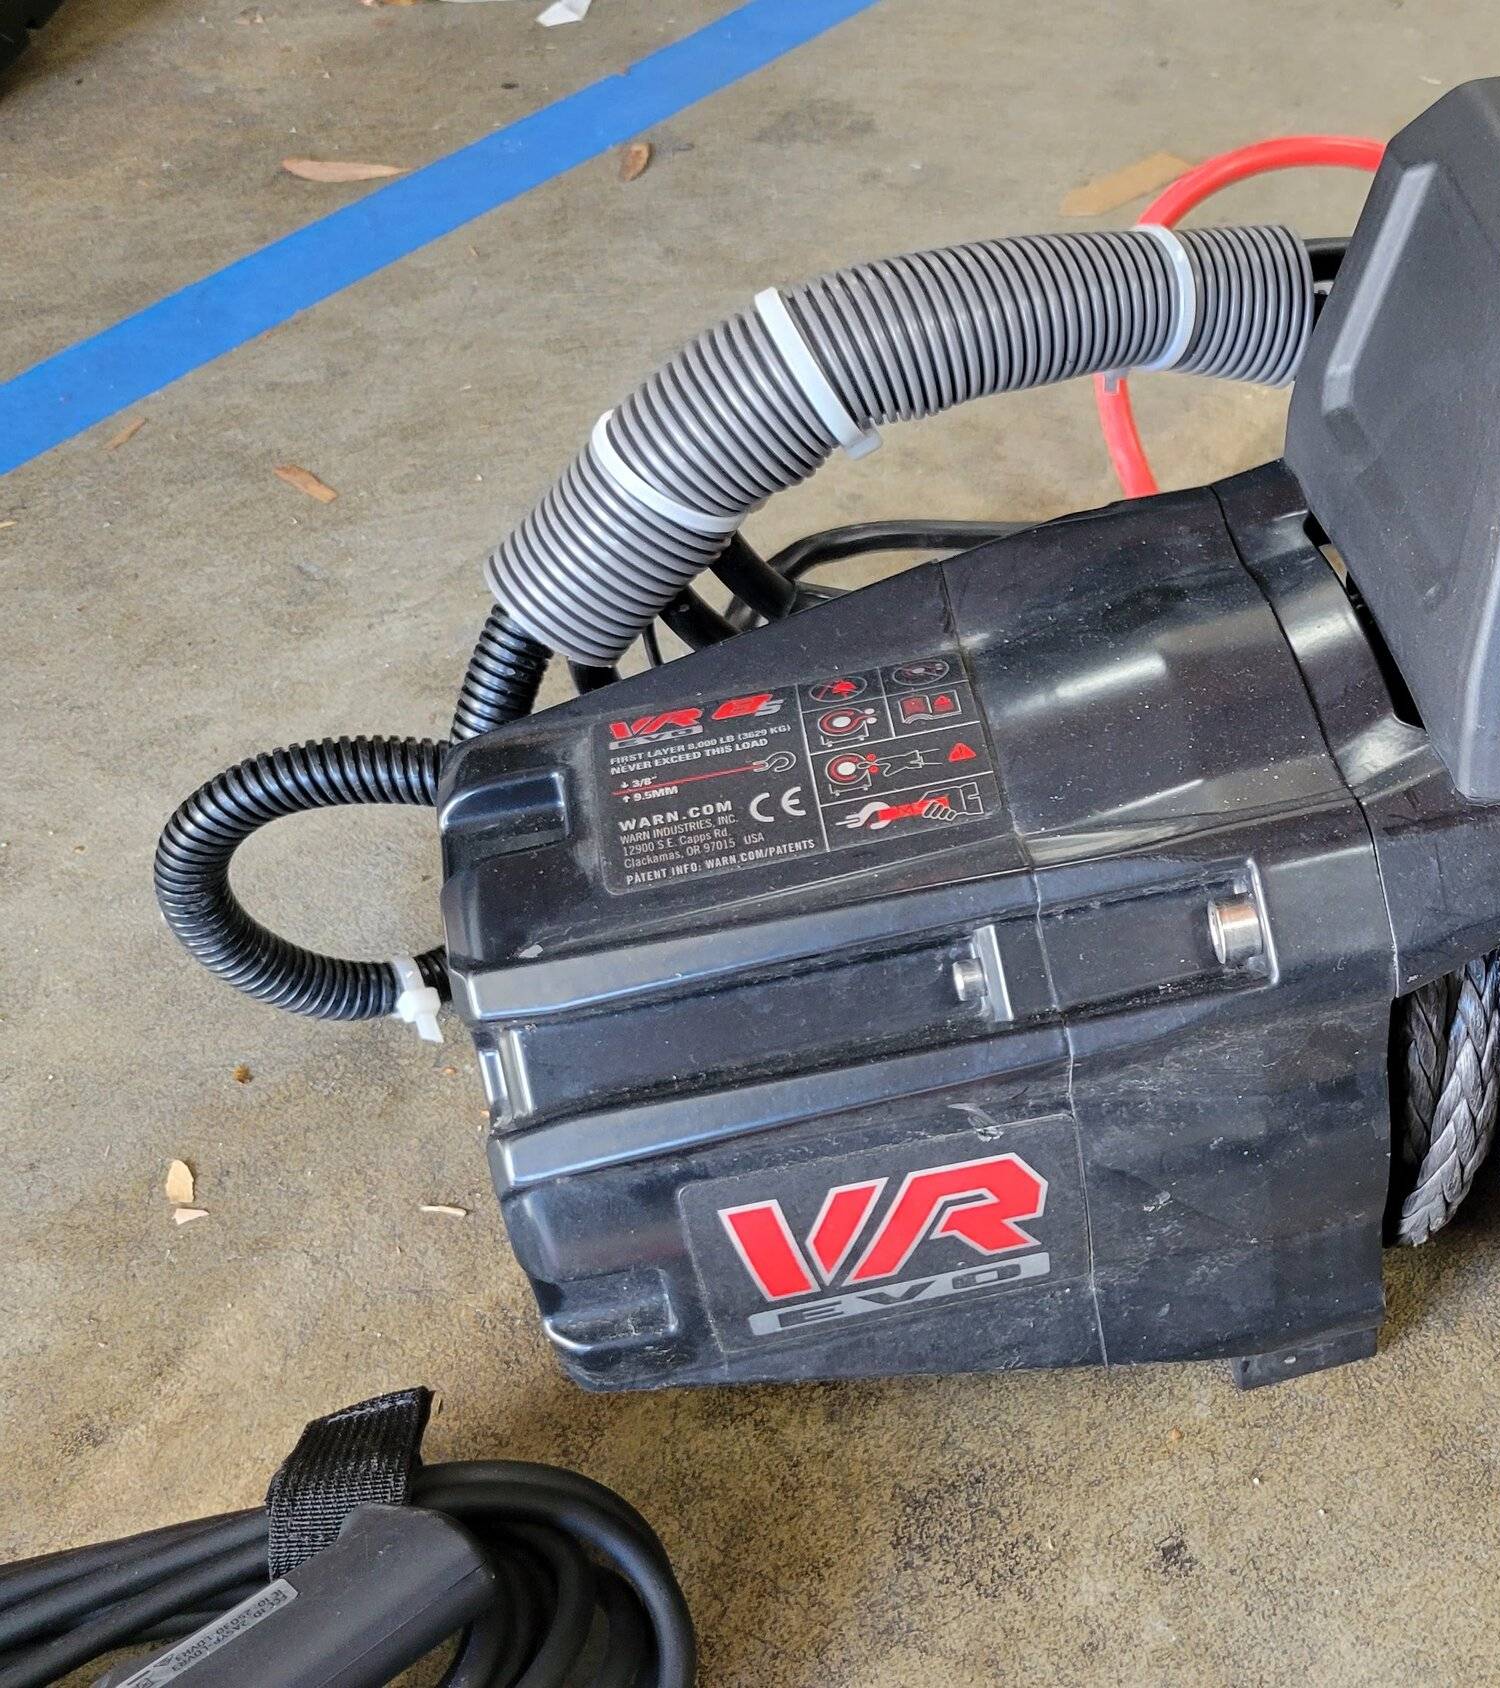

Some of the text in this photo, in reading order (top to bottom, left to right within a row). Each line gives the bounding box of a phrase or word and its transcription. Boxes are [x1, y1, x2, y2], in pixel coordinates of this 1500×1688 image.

[608, 707, 704, 740] VR
[609, 752, 644, 765] FIRST
[647, 744, 685, 758] LAYER
[719, 734, 734, 744] LB
[738, 728, 767, 741] (3629
[769, 723, 791, 734] KG)
[610, 738, 768, 775] NEVER EXCEED THIS LOAD
[633, 785, 678, 801] 9.5MM
[618, 800, 732, 832] WARN.COM
[620, 813, 738, 844] WARN INDUSTRIES, INC.
[622, 842, 654, 856] 12900
[679, 831, 712, 847] Capps
[713, 827, 731, 838] Rd.
[623, 832, 764, 869] Clackamas, OR 97015 USA
[626, 839, 815, 885] PATENT INFO: WARN.COM/PATENTS
[717, 1152, 1048, 1301] VR
[765, 1258, 1034, 1332] EVO
